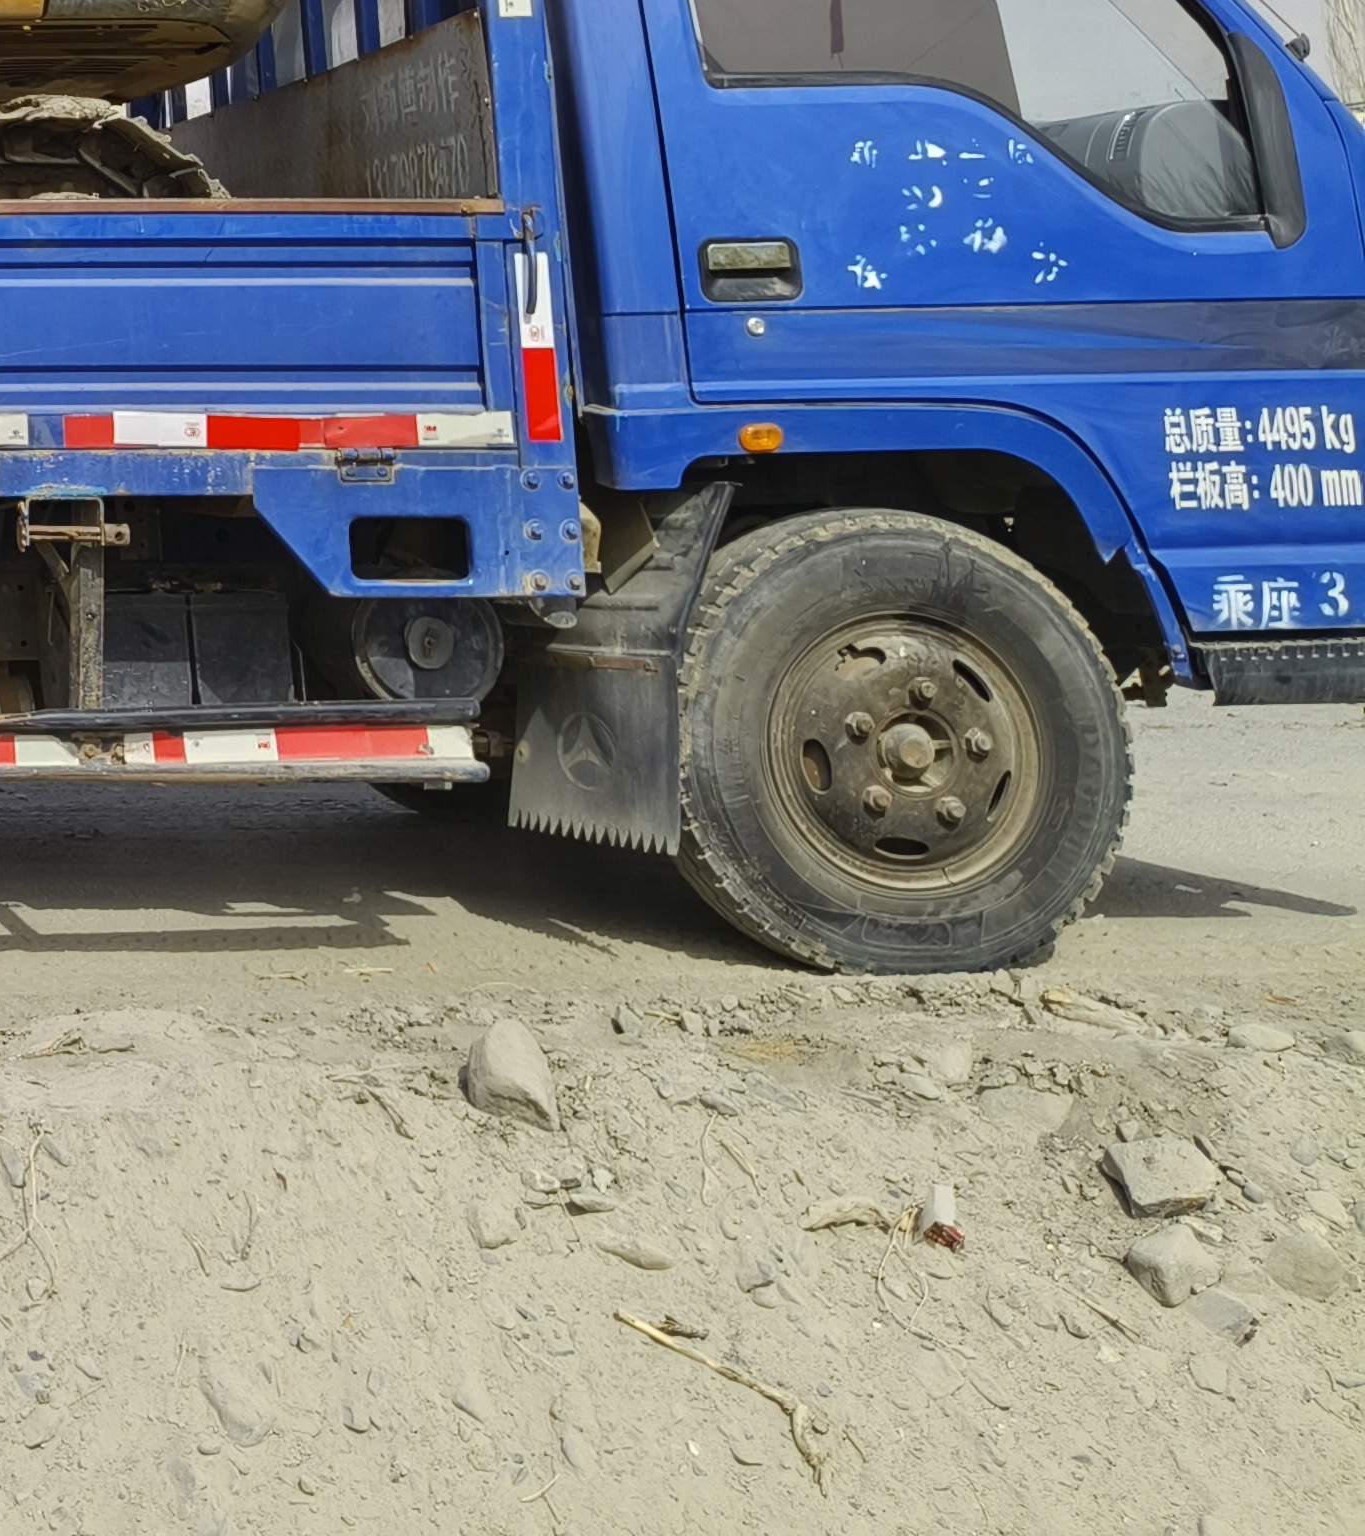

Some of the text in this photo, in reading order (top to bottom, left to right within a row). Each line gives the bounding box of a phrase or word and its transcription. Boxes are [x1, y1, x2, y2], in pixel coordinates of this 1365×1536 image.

[1321, 405, 1356, 453] kg
[1270, 464, 1313, 507] 400
[1321, 469, 1363, 506] mm
[1319, 571, 1350, 616] 3
